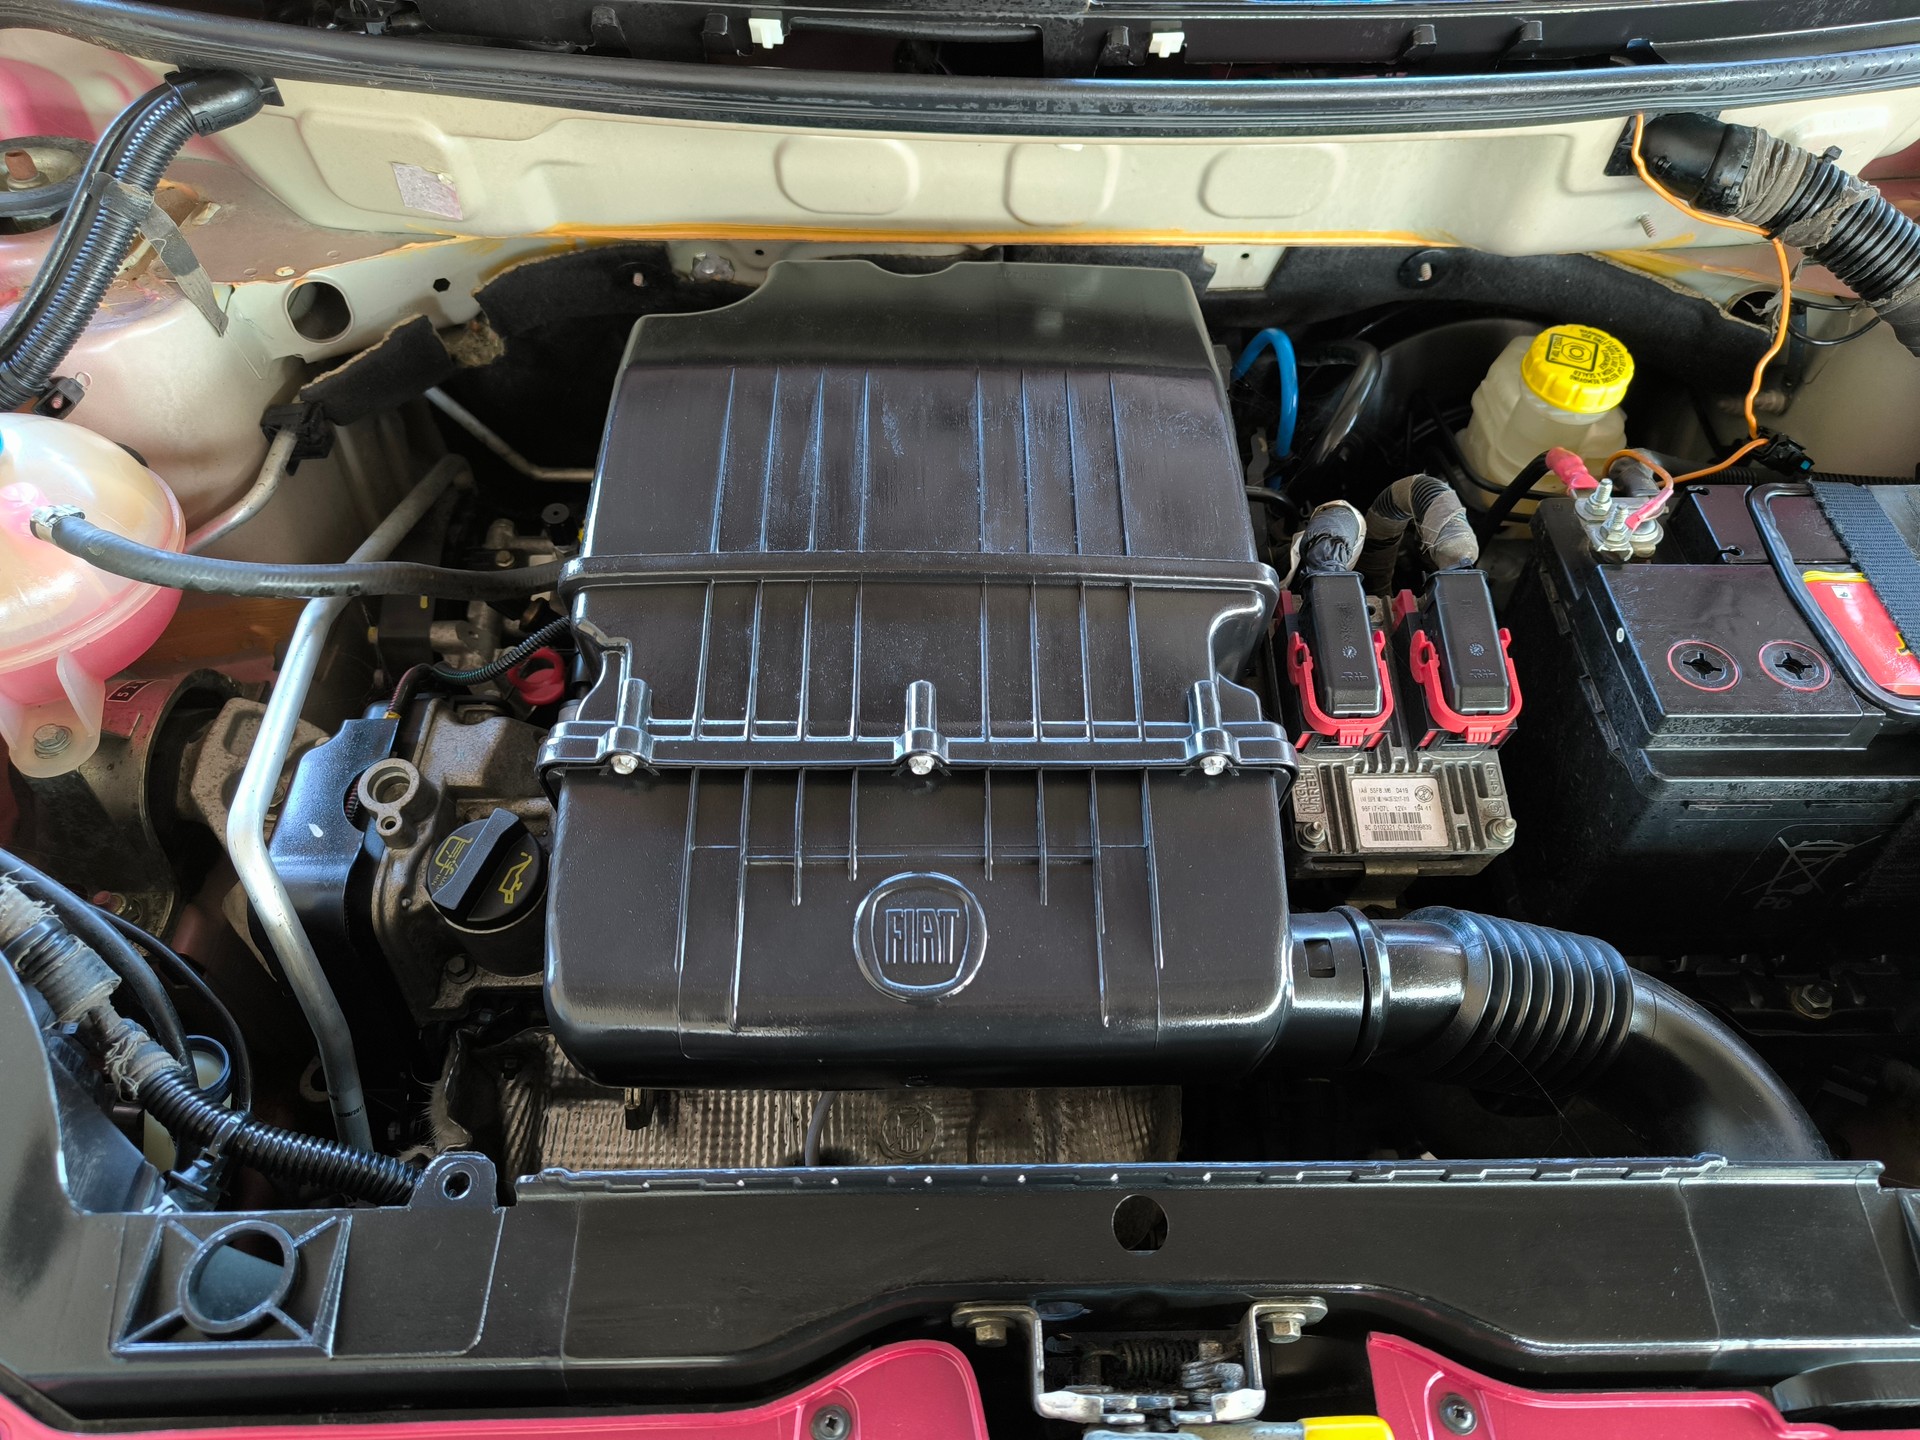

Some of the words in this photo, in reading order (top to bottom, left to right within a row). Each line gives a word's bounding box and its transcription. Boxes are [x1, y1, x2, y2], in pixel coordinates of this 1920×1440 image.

[1617, 367, 1625, 375] CAP
[1569, 374, 1600, 384] REMOVING
[1601, 373, 1620, 384] BEFORE
[1753, 896, 1792, 910] Pb
[885, 908, 960, 964] FIAT
